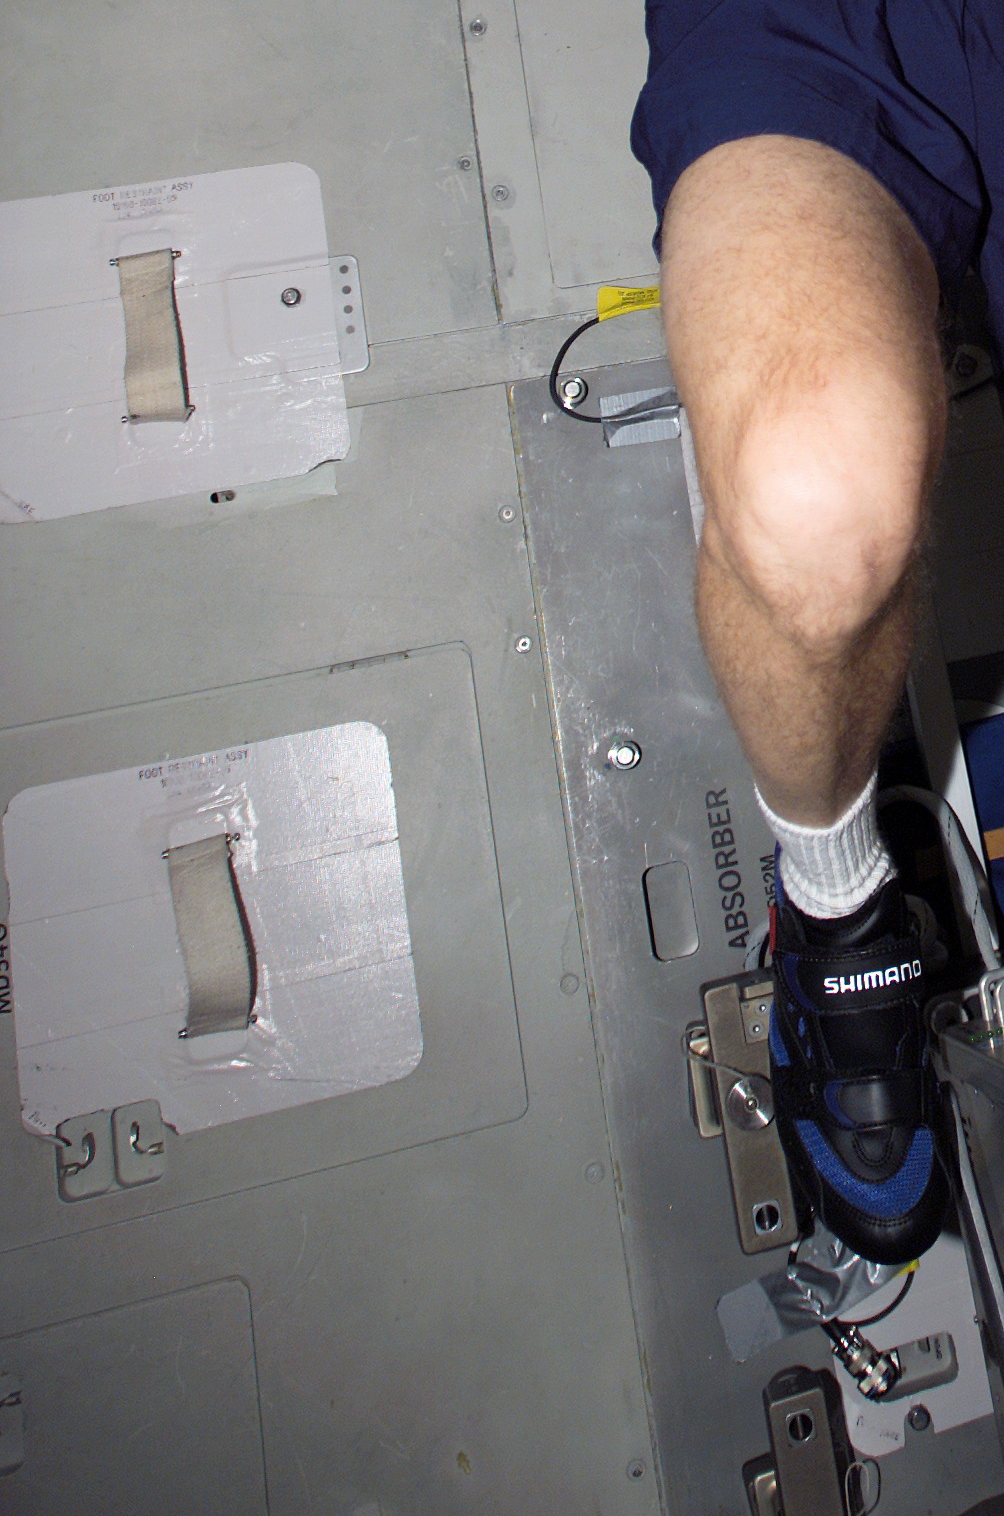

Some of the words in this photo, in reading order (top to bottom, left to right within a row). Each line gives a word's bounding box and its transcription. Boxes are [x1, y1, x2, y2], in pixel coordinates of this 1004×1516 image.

[93, 193, 114, 202] FOOT
[705, 787, 749, 948] ABSORBER
[824, 959, 921, 994] SHIMANO
